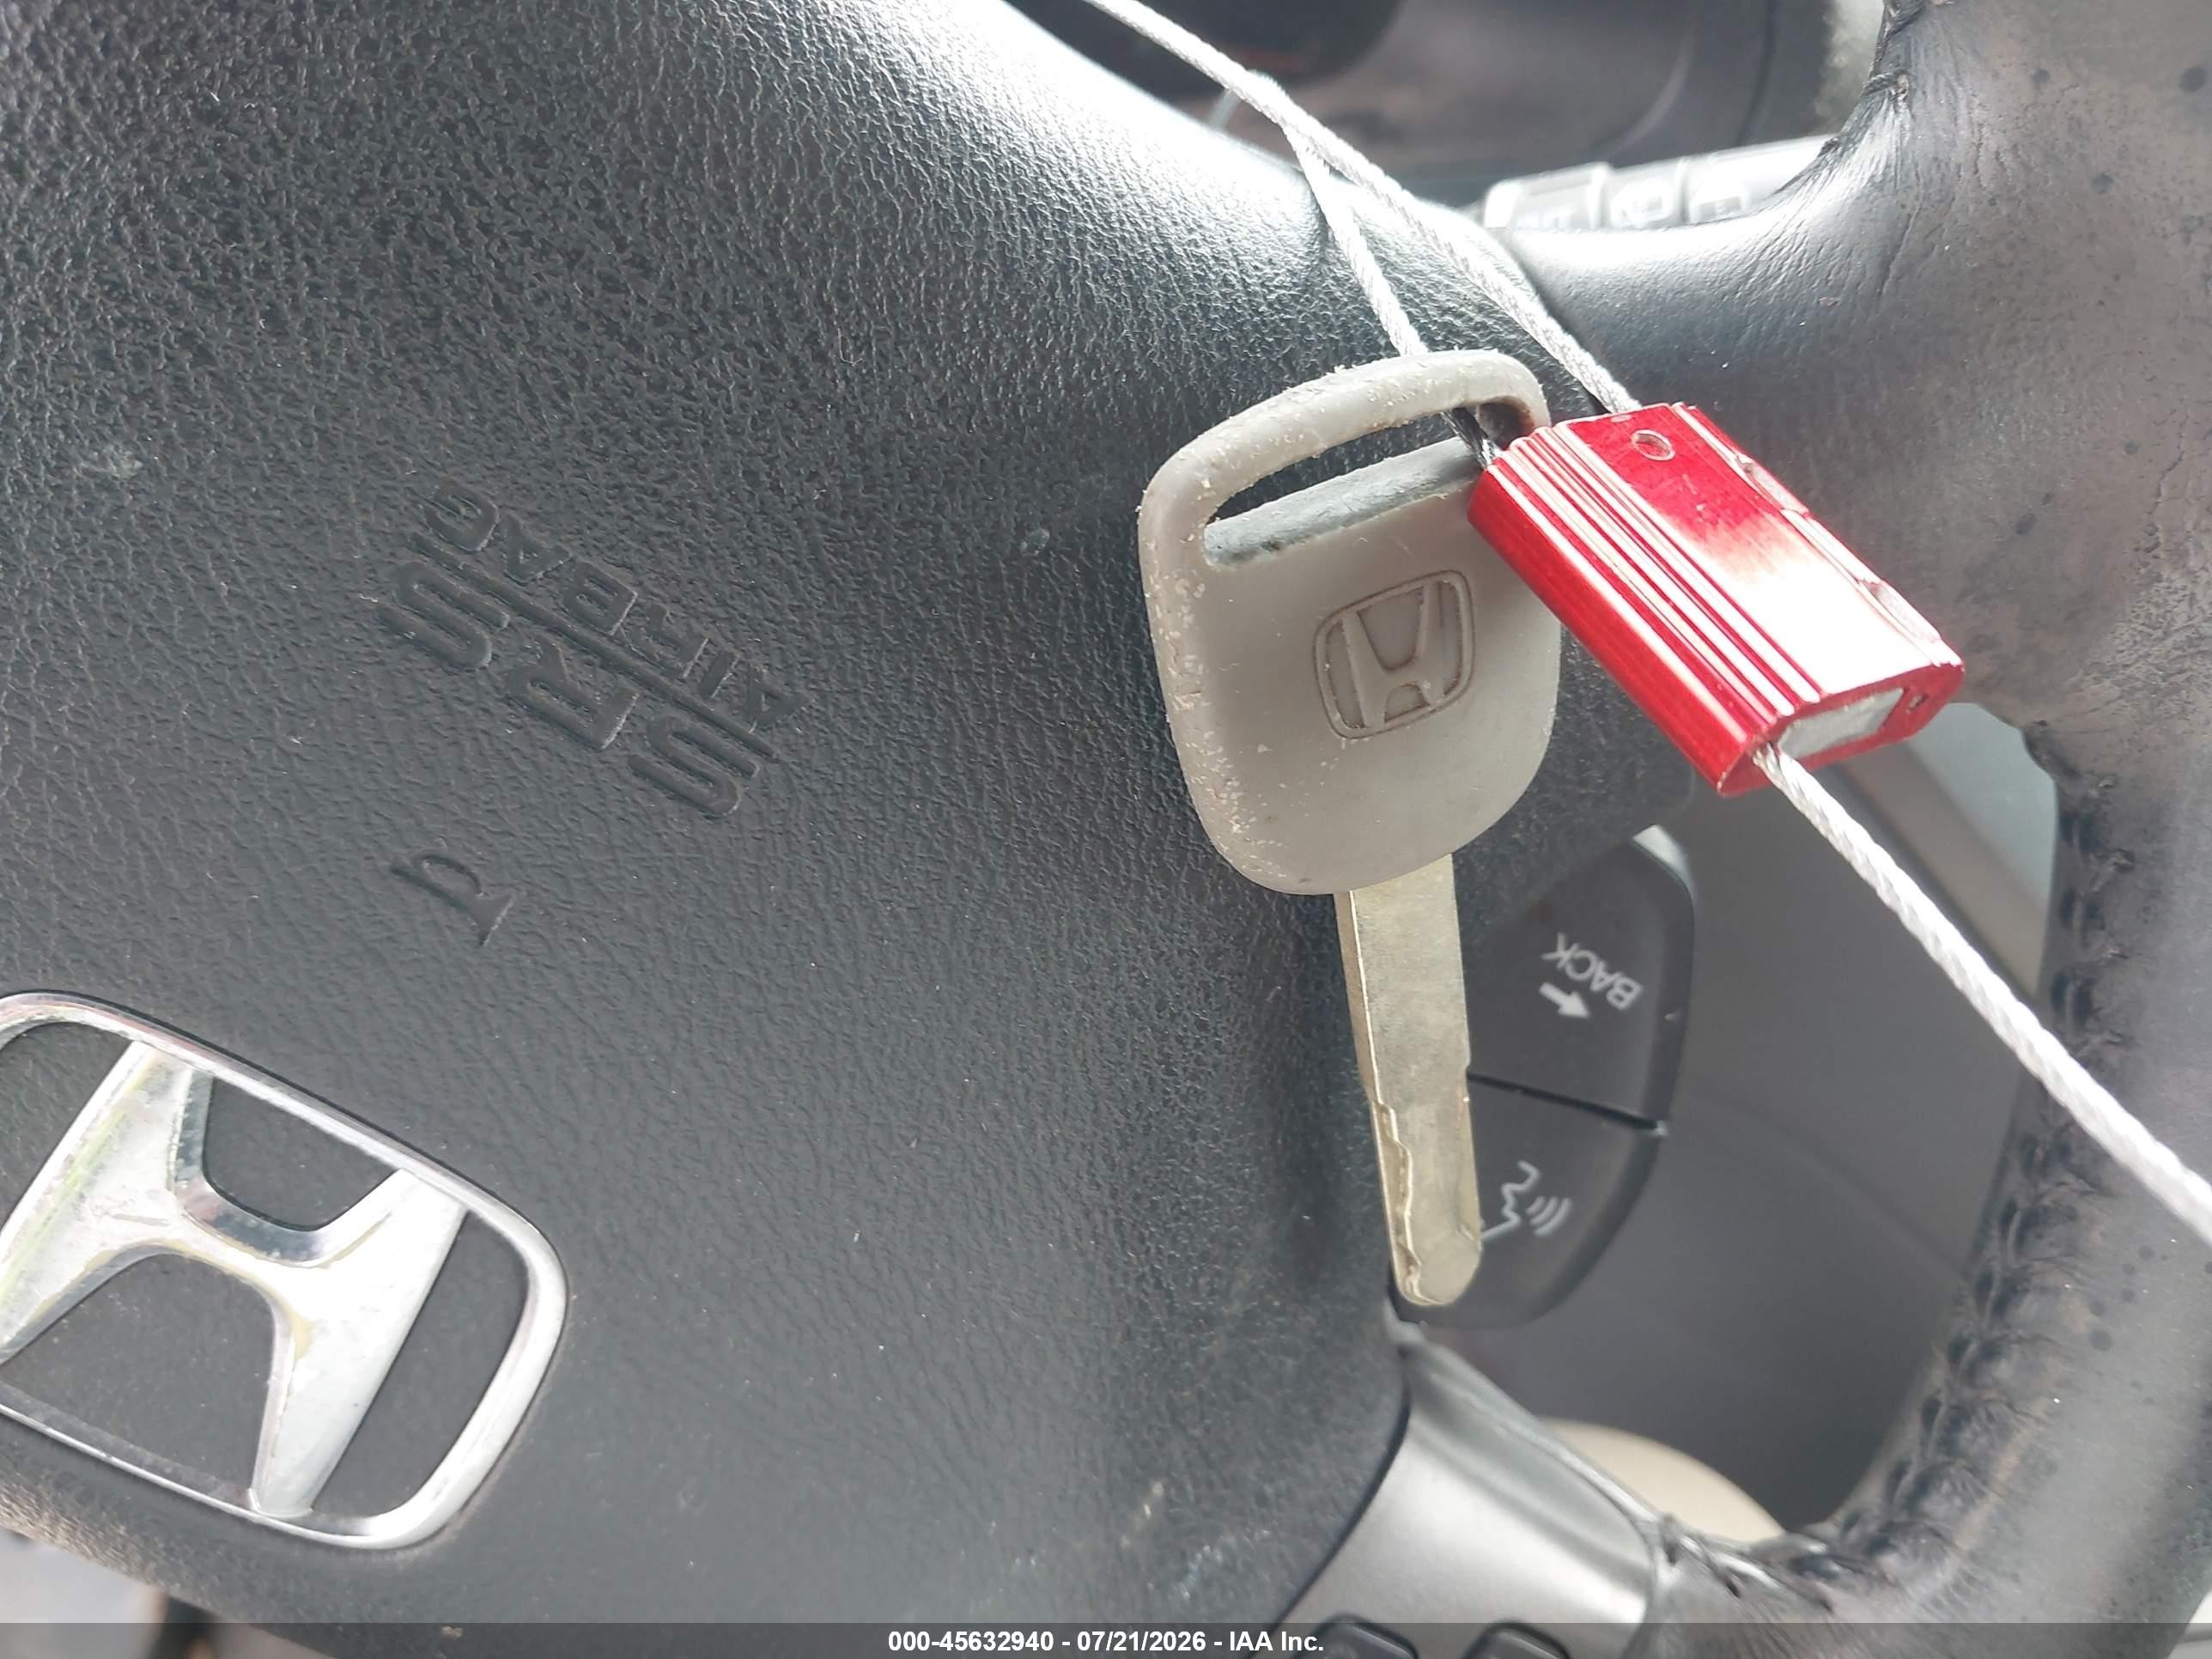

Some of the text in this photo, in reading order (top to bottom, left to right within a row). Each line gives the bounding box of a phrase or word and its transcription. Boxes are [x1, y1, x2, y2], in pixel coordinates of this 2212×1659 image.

[376, 558, 759, 817] SRS
[428, 483, 815, 733] AIRBAG
[1540, 933, 1642, 1010] BACK
